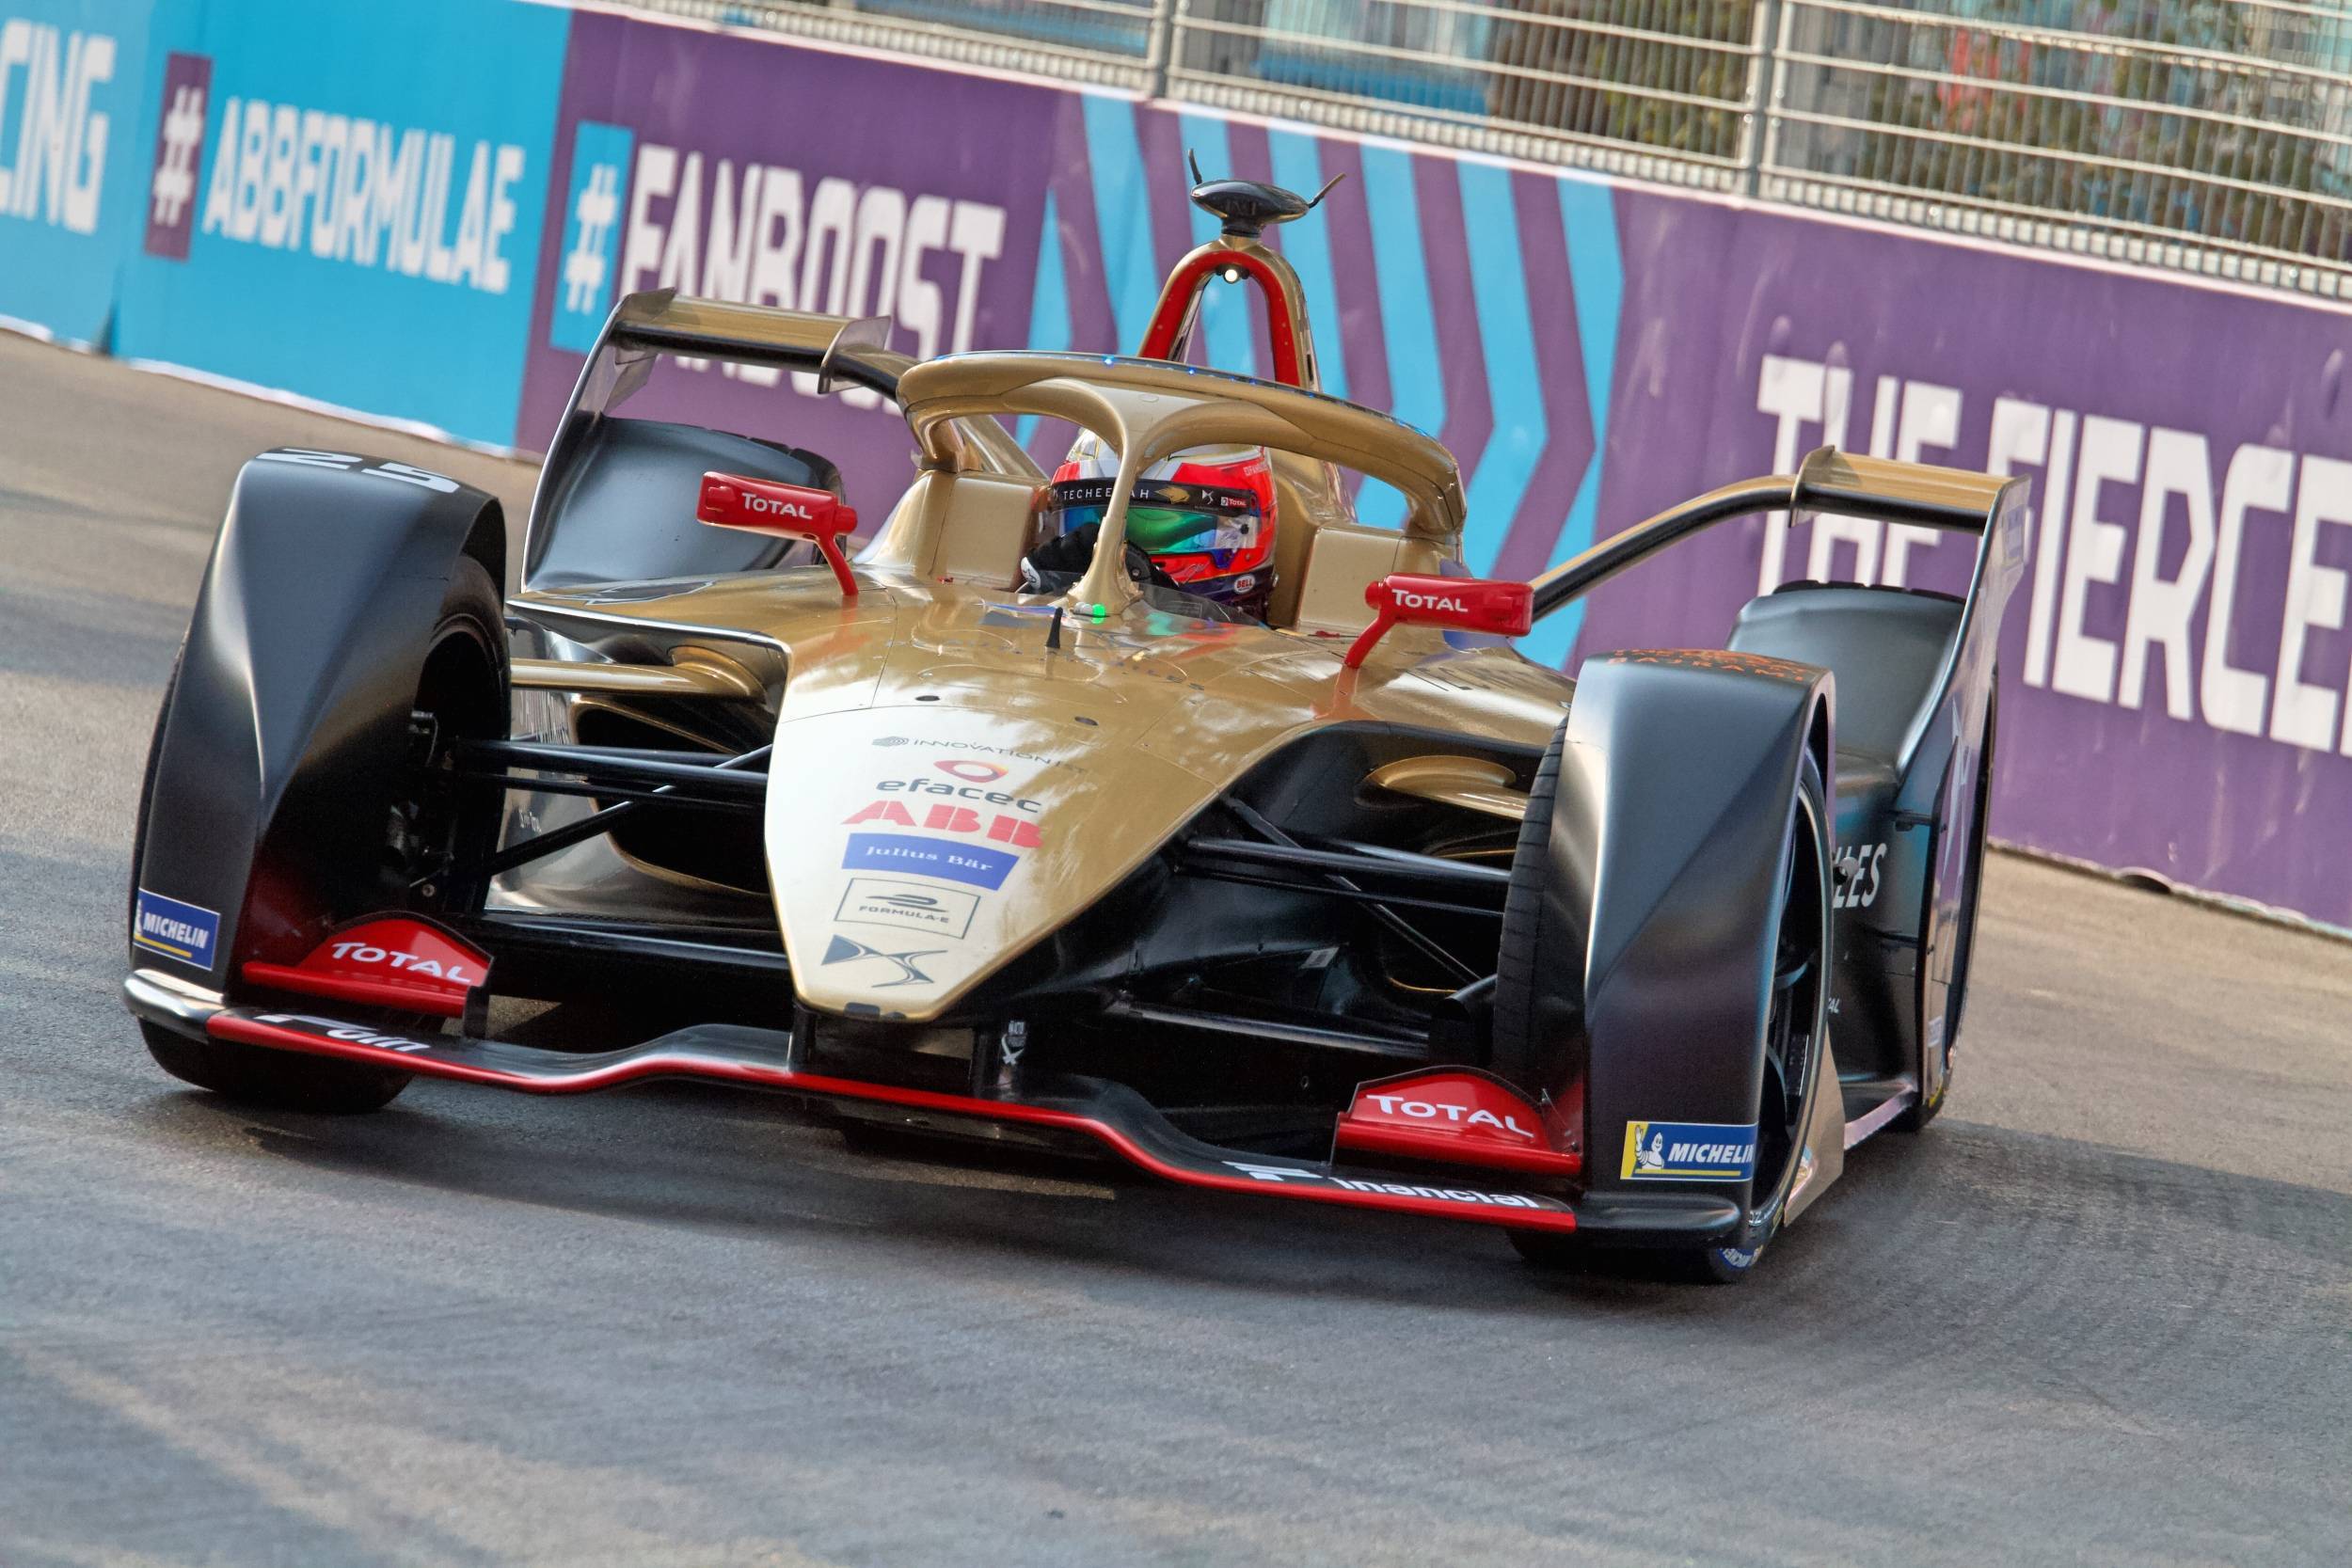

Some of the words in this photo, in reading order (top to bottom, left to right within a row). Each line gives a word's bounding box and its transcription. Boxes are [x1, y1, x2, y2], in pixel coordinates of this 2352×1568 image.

[741, 492, 814, 520] TOTAL
[1063, 486, 1150, 501] TECHEEAH
[1236, 578, 1252, 590] BELL
[1987, 397, 2352, 756] IERCE
[1391, 589, 1469, 612] TOTAL
[876, 778, 1041, 814] efacec
[840, 800, 1044, 848] ABB
[866, 845, 939, 862] Julius
[947, 854, 993, 872] Bär
[142, 911, 209, 949] MICHELIN
[332, 942, 471, 984] TOTAL
[1365, 1094, 1534, 1138] TOTAL
[1667, 1143, 1755, 1164] MICHELIN
